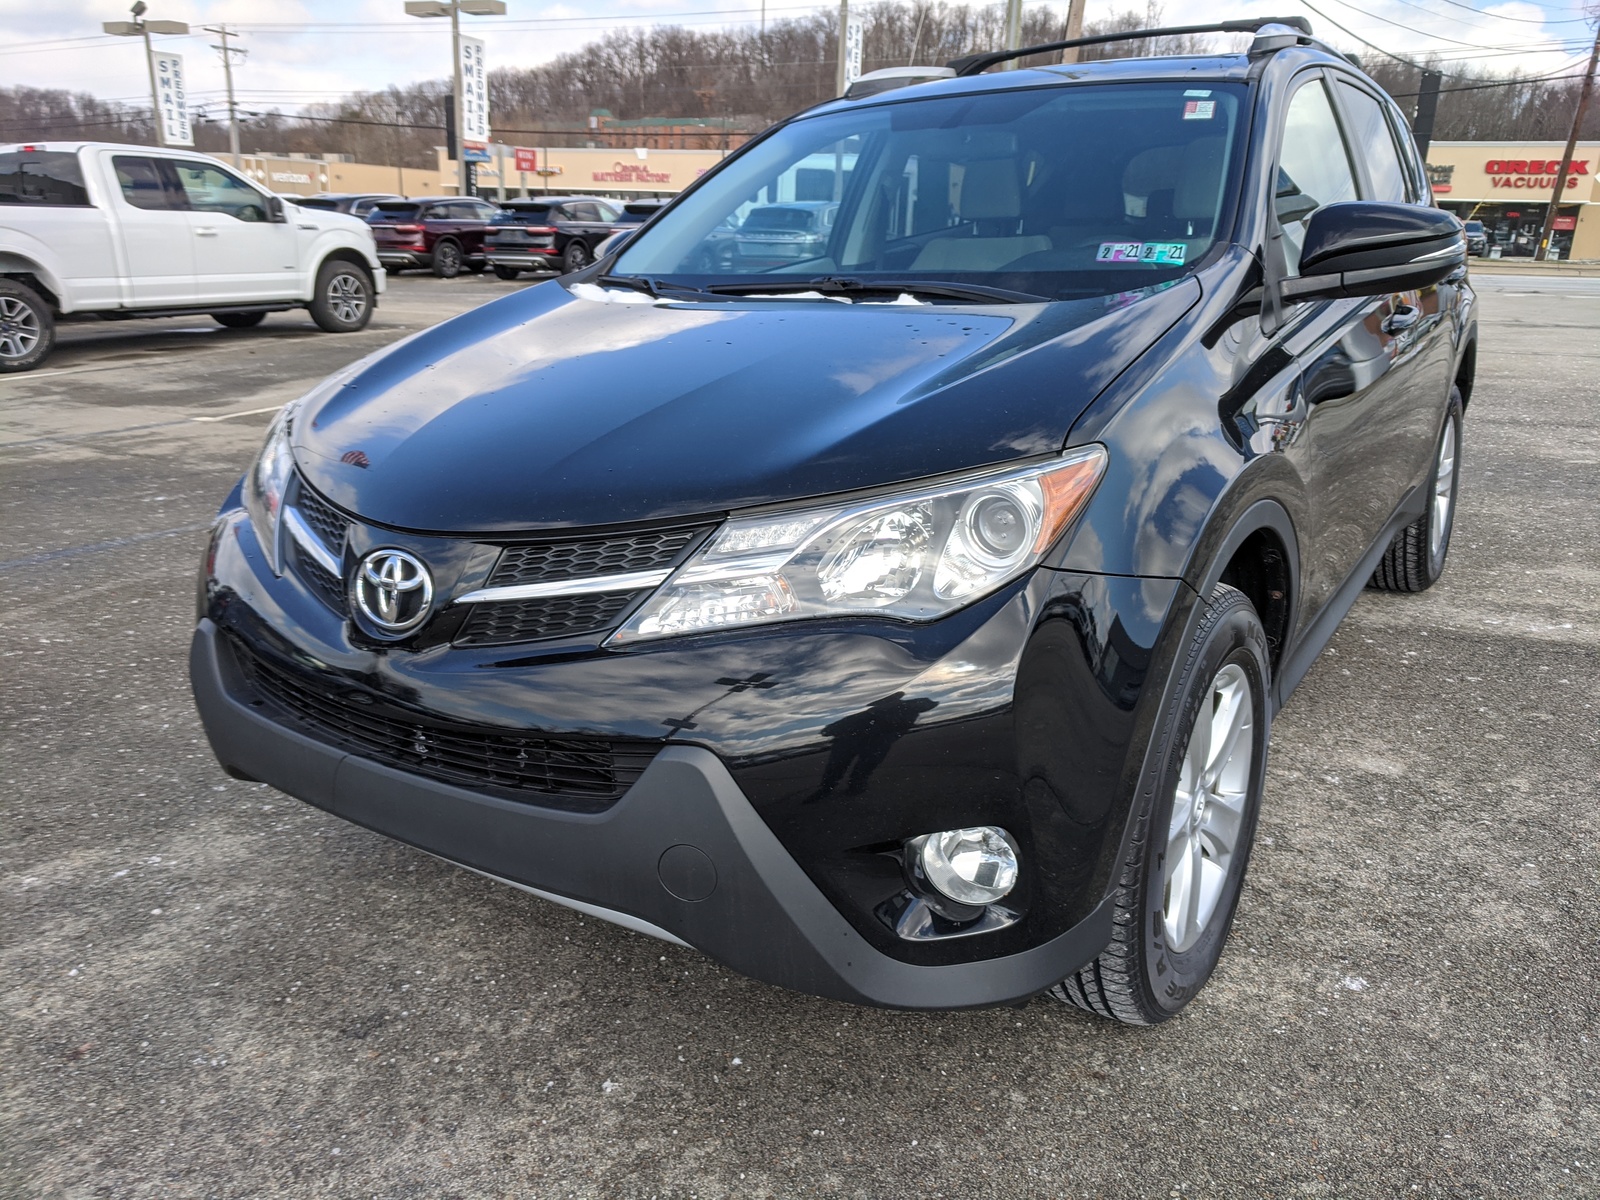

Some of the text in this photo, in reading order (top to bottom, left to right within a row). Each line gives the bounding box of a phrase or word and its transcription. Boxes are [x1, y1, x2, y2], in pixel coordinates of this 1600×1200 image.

[159, 60, 177, 136] SMAIL
[171, 59, 189, 140] PREOWNED
[464, 45, 474, 131] SMAIL
[475, 45, 485, 135] PREOWNED
[1485, 160, 1589, 174] ORECK
[1126, 245, 1139, 257] 21
[1170, 246, 1183, 259] 21
